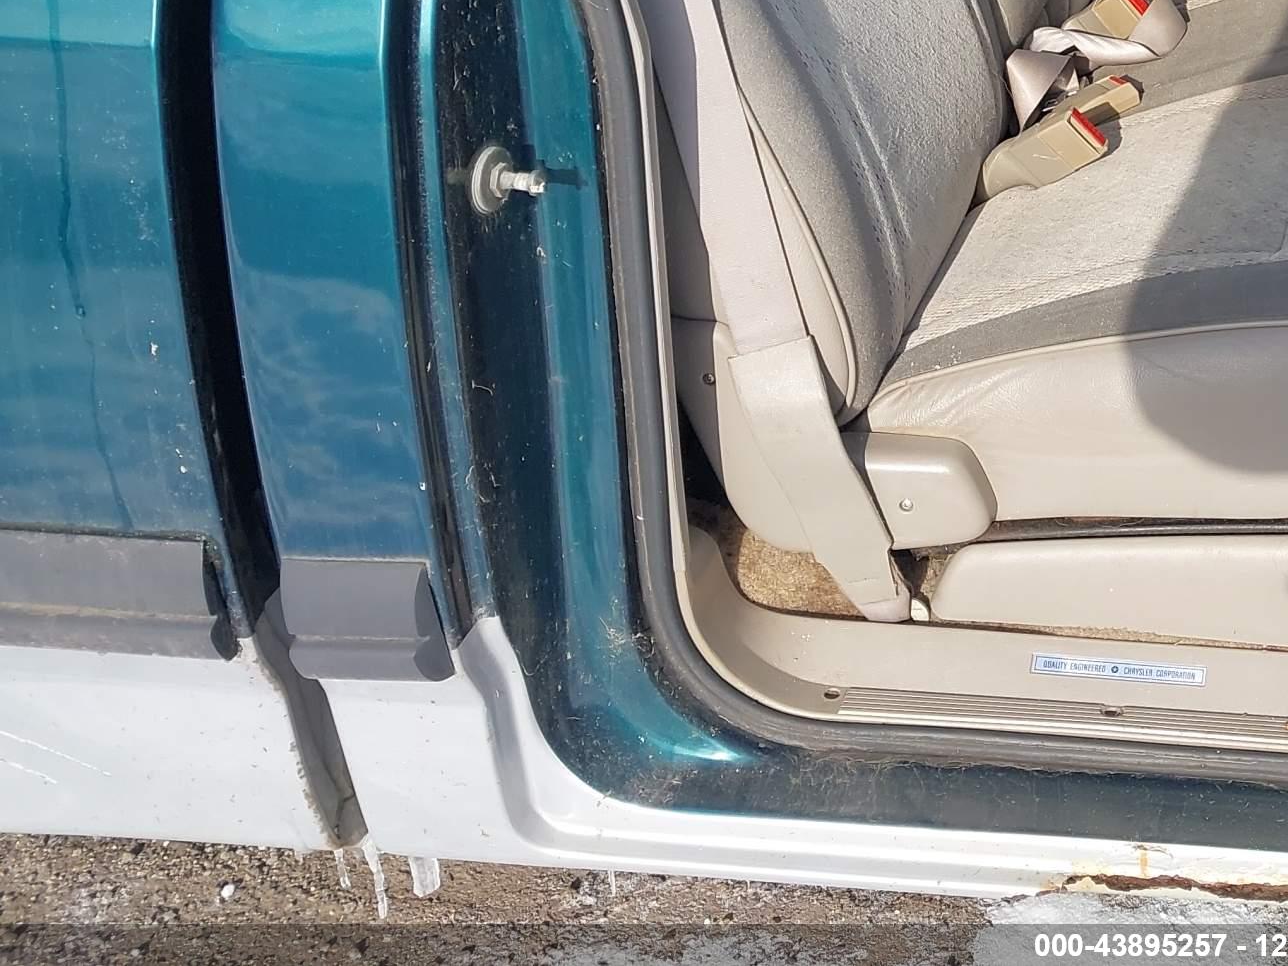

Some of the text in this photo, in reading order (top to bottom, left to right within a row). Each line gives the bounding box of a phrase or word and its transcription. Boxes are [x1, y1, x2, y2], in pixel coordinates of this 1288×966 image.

[1043, 659, 1196, 681] QUALITY ENGINEERED CHRYSLER CORPORATION
